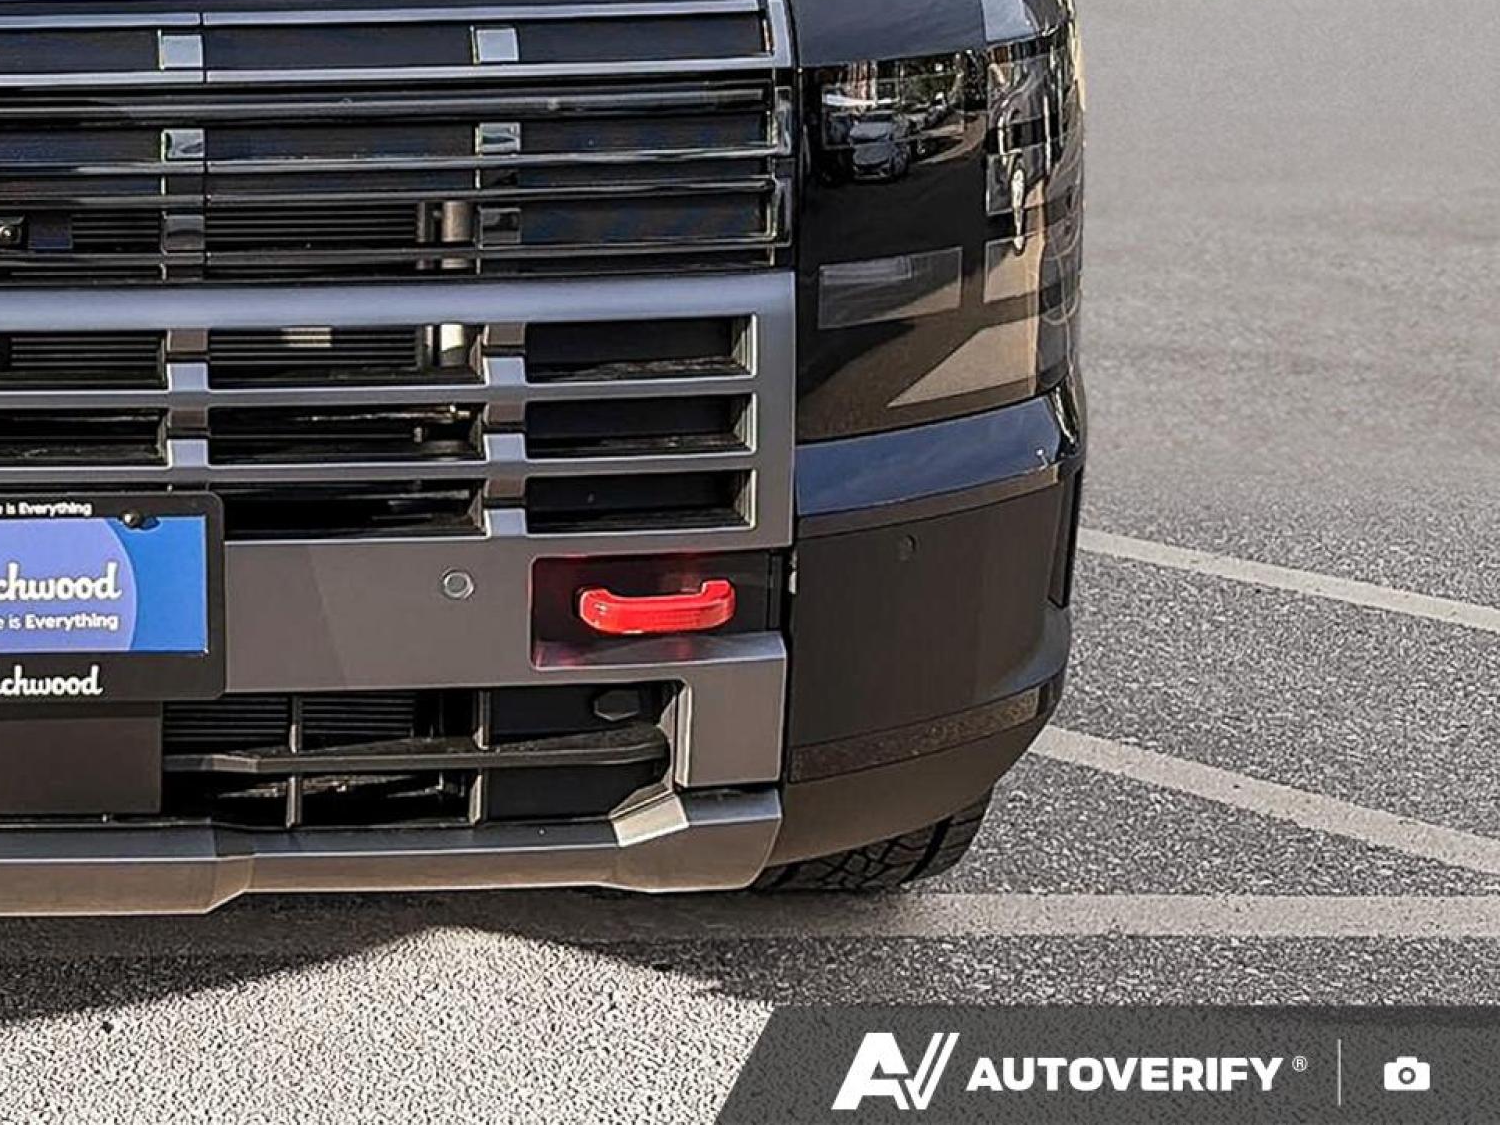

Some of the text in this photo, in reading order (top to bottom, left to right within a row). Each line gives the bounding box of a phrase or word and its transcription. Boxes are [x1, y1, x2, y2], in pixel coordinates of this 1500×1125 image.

[6, 502, 17, 515] is
[19, 502, 93, 517] Everything
[8, 615, 21, 629] is
[25, 613, 119, 632] Everything
